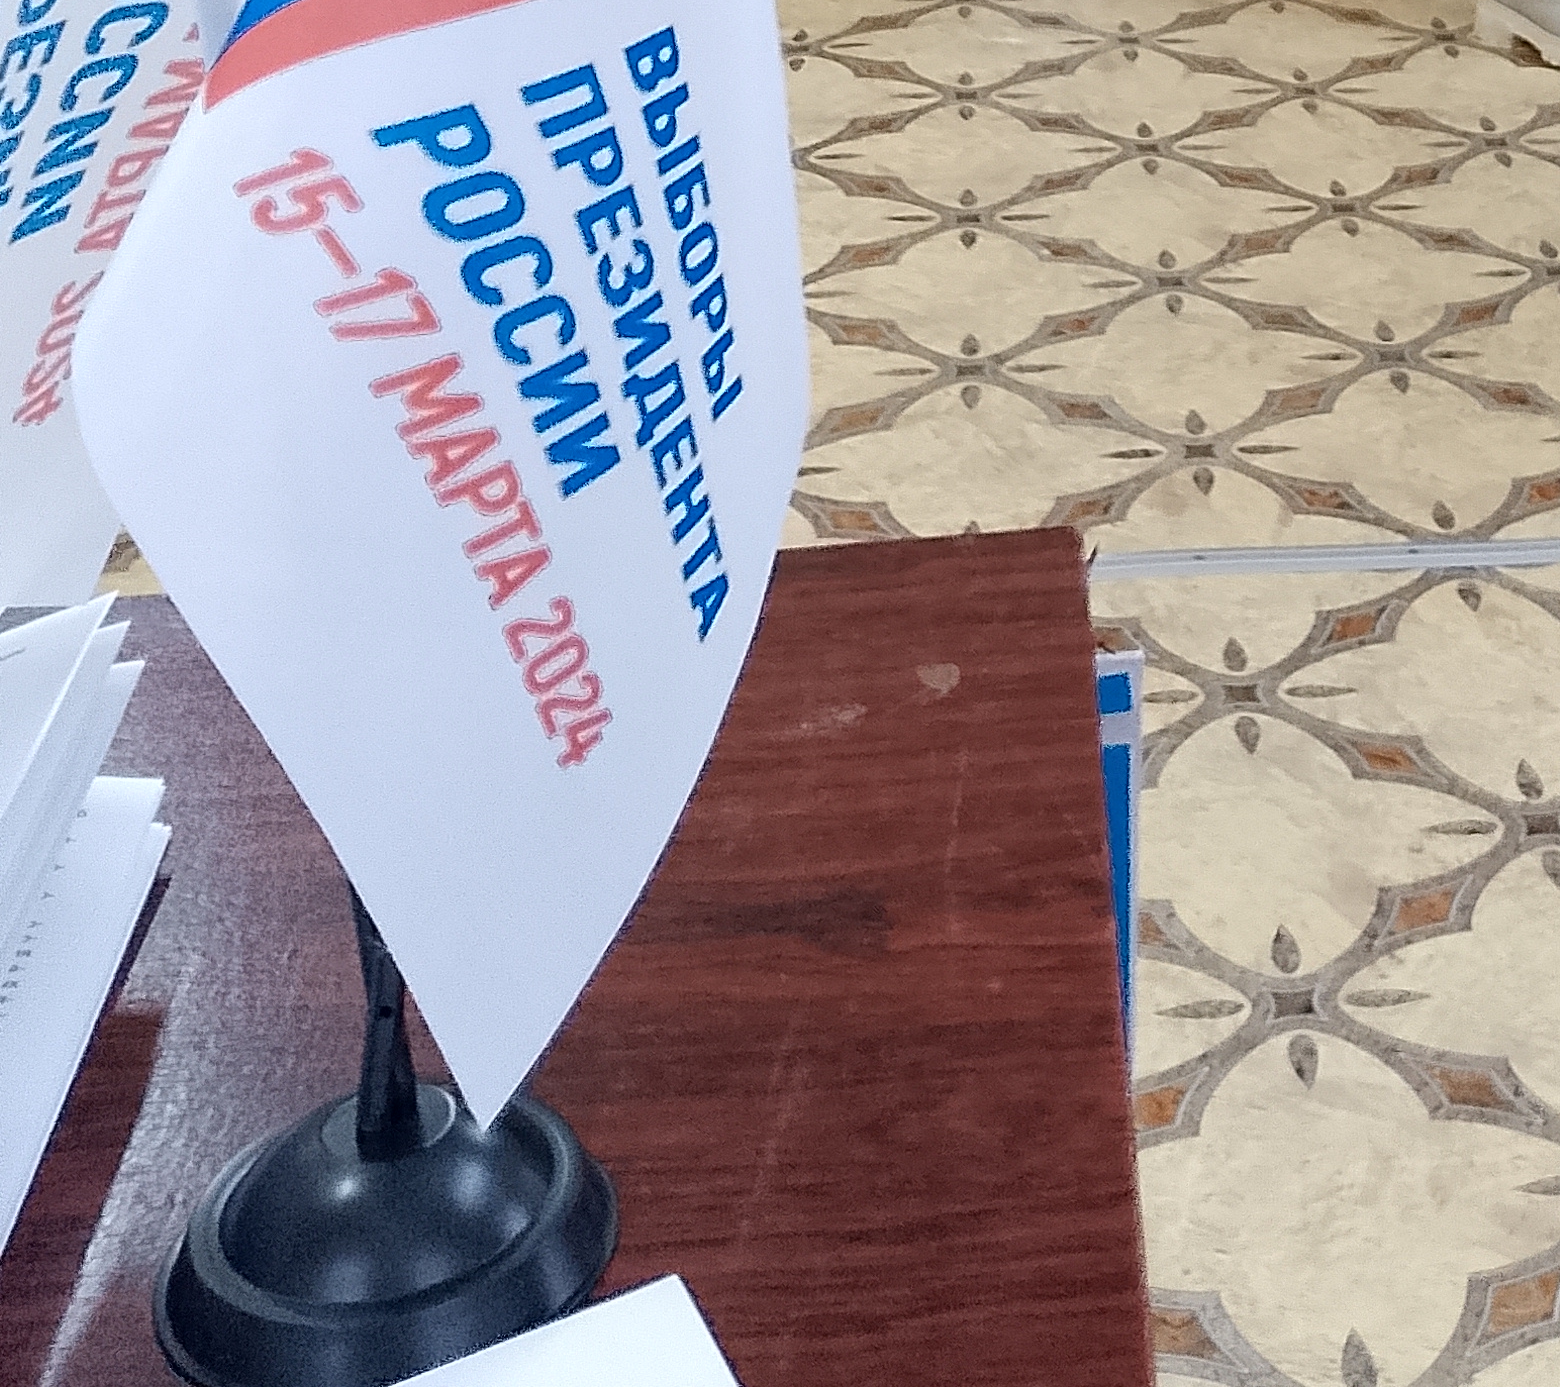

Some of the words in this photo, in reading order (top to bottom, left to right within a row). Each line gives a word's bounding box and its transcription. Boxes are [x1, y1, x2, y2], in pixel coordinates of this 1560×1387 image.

[369, 102, 623, 500] РОССИИ
[519, 62, 731, 643] ПРЕЗИДЕНТА
[624, 23, 745, 423] ВЫБОРЫ
[368, 352, 553, 611] МАРТА
[500, 594, 614, 770] 2024
